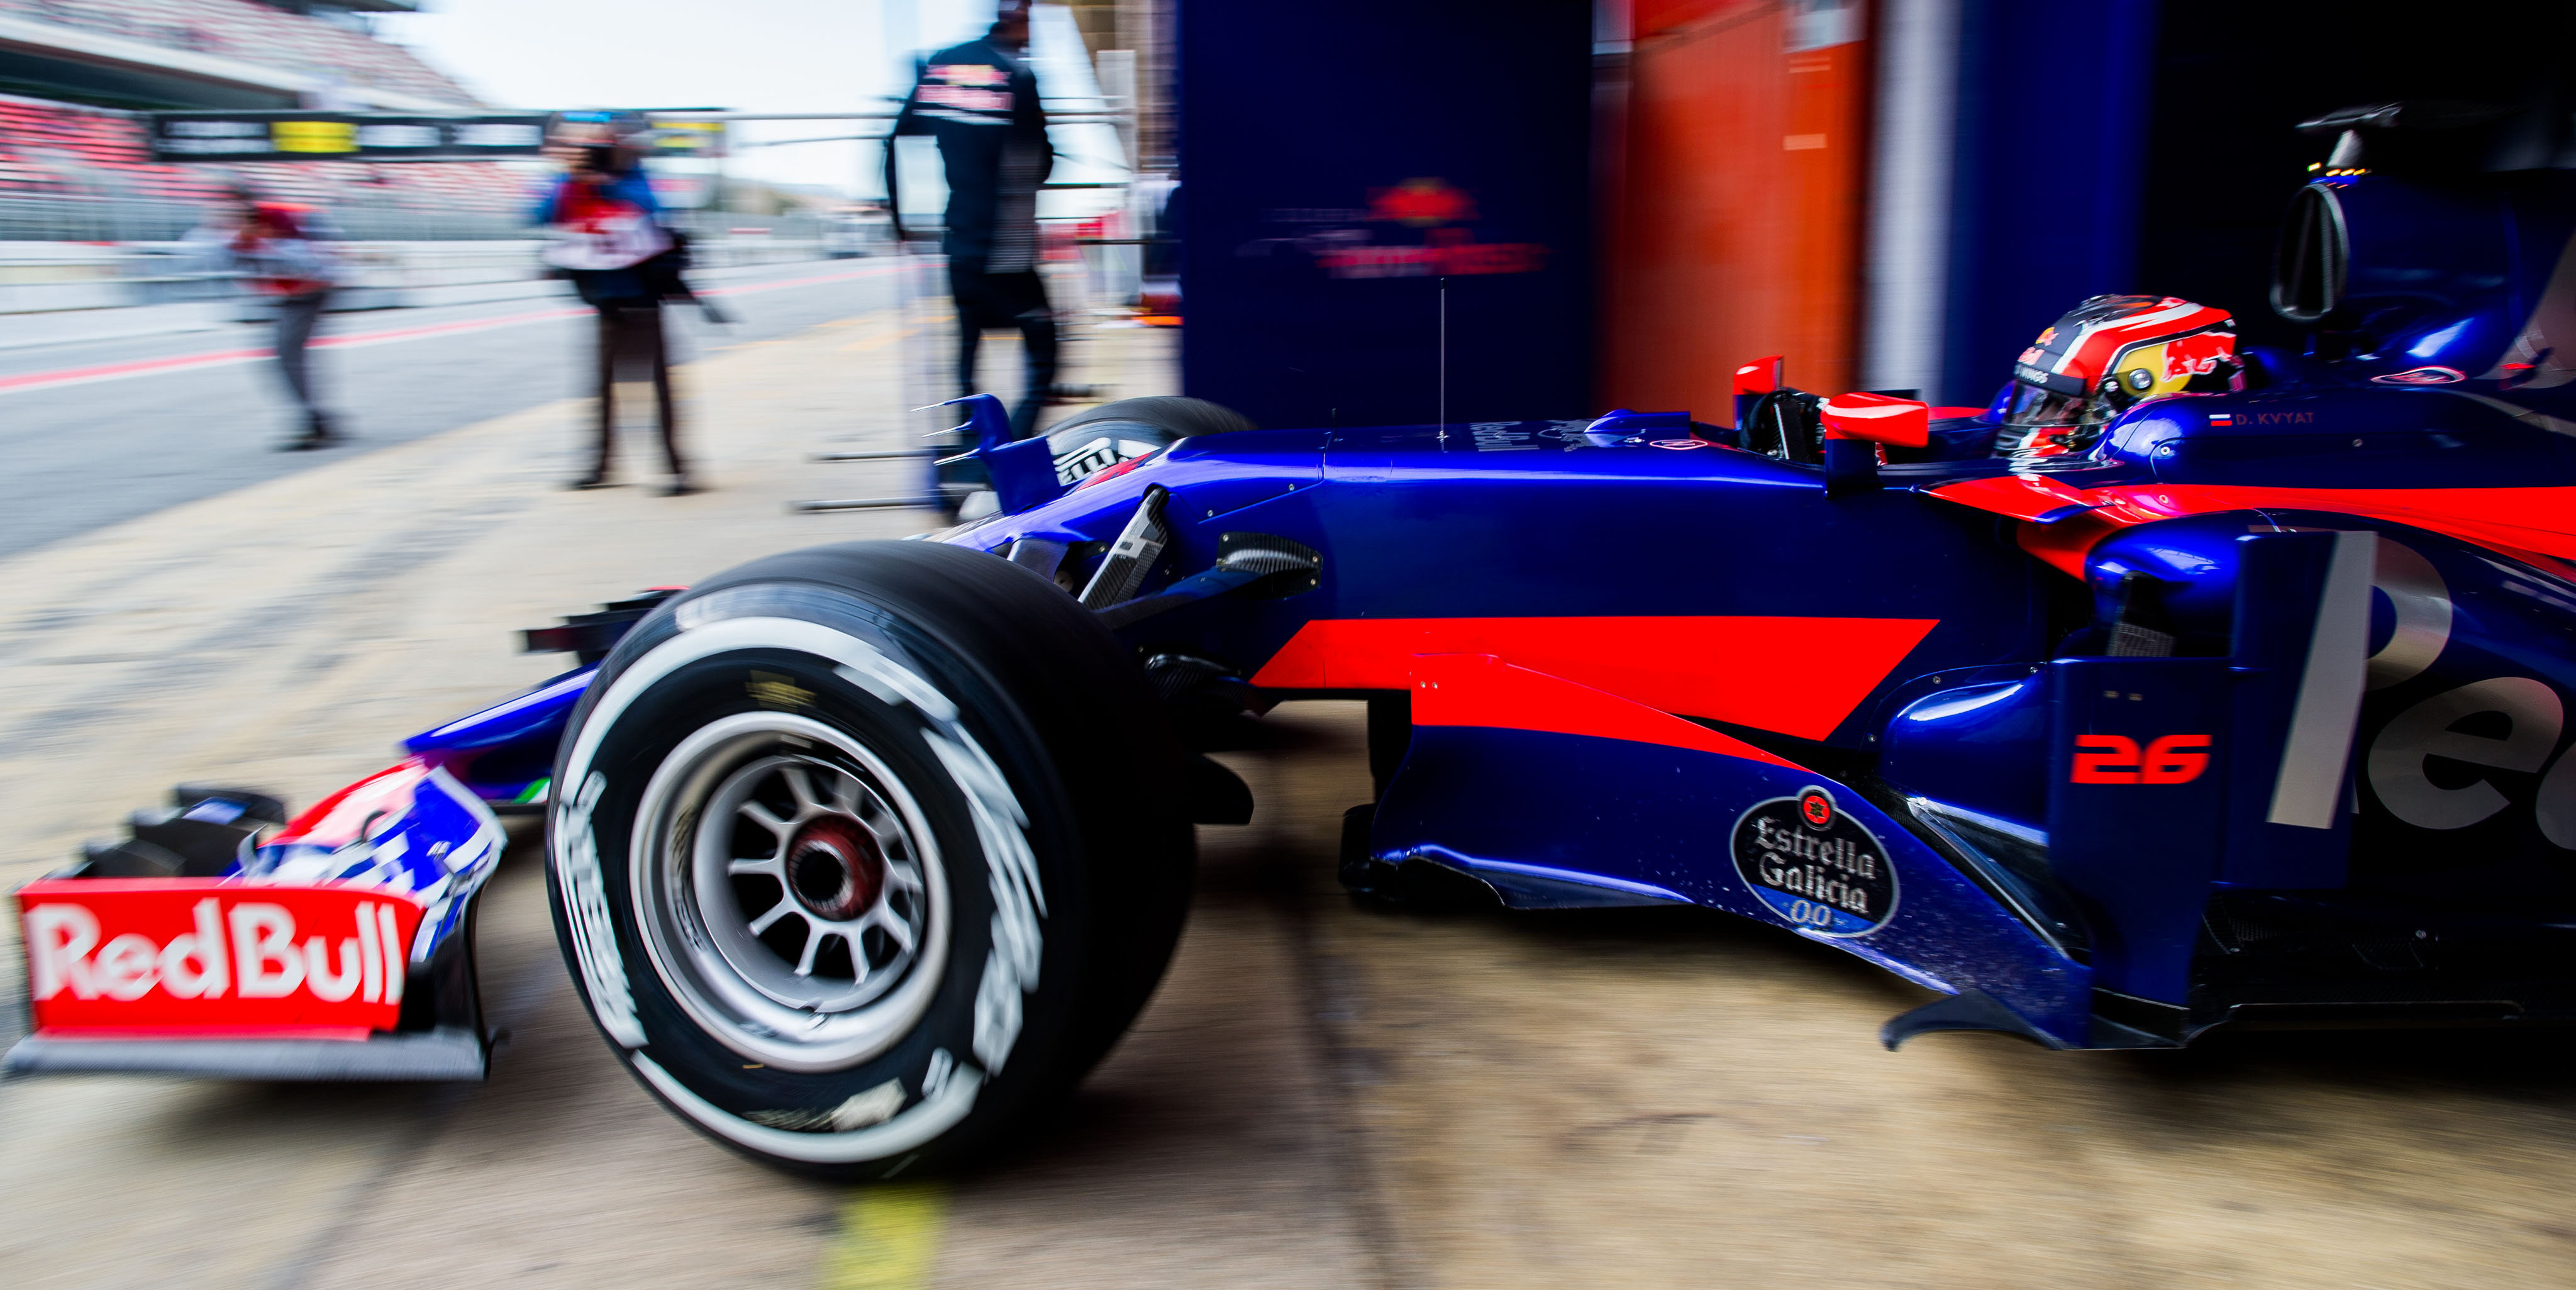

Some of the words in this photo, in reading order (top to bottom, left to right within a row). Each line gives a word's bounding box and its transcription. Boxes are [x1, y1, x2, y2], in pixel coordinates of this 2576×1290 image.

[2236, 414, 2253, 425] D.
[2258, 412, 2314, 425] KVYAT
[2248, 526, 2576, 850] Re
[2070, 734, 2212, 785] 26
[1754, 816, 1877, 880] Estrella
[1759, 851, 1869, 914] Galicia
